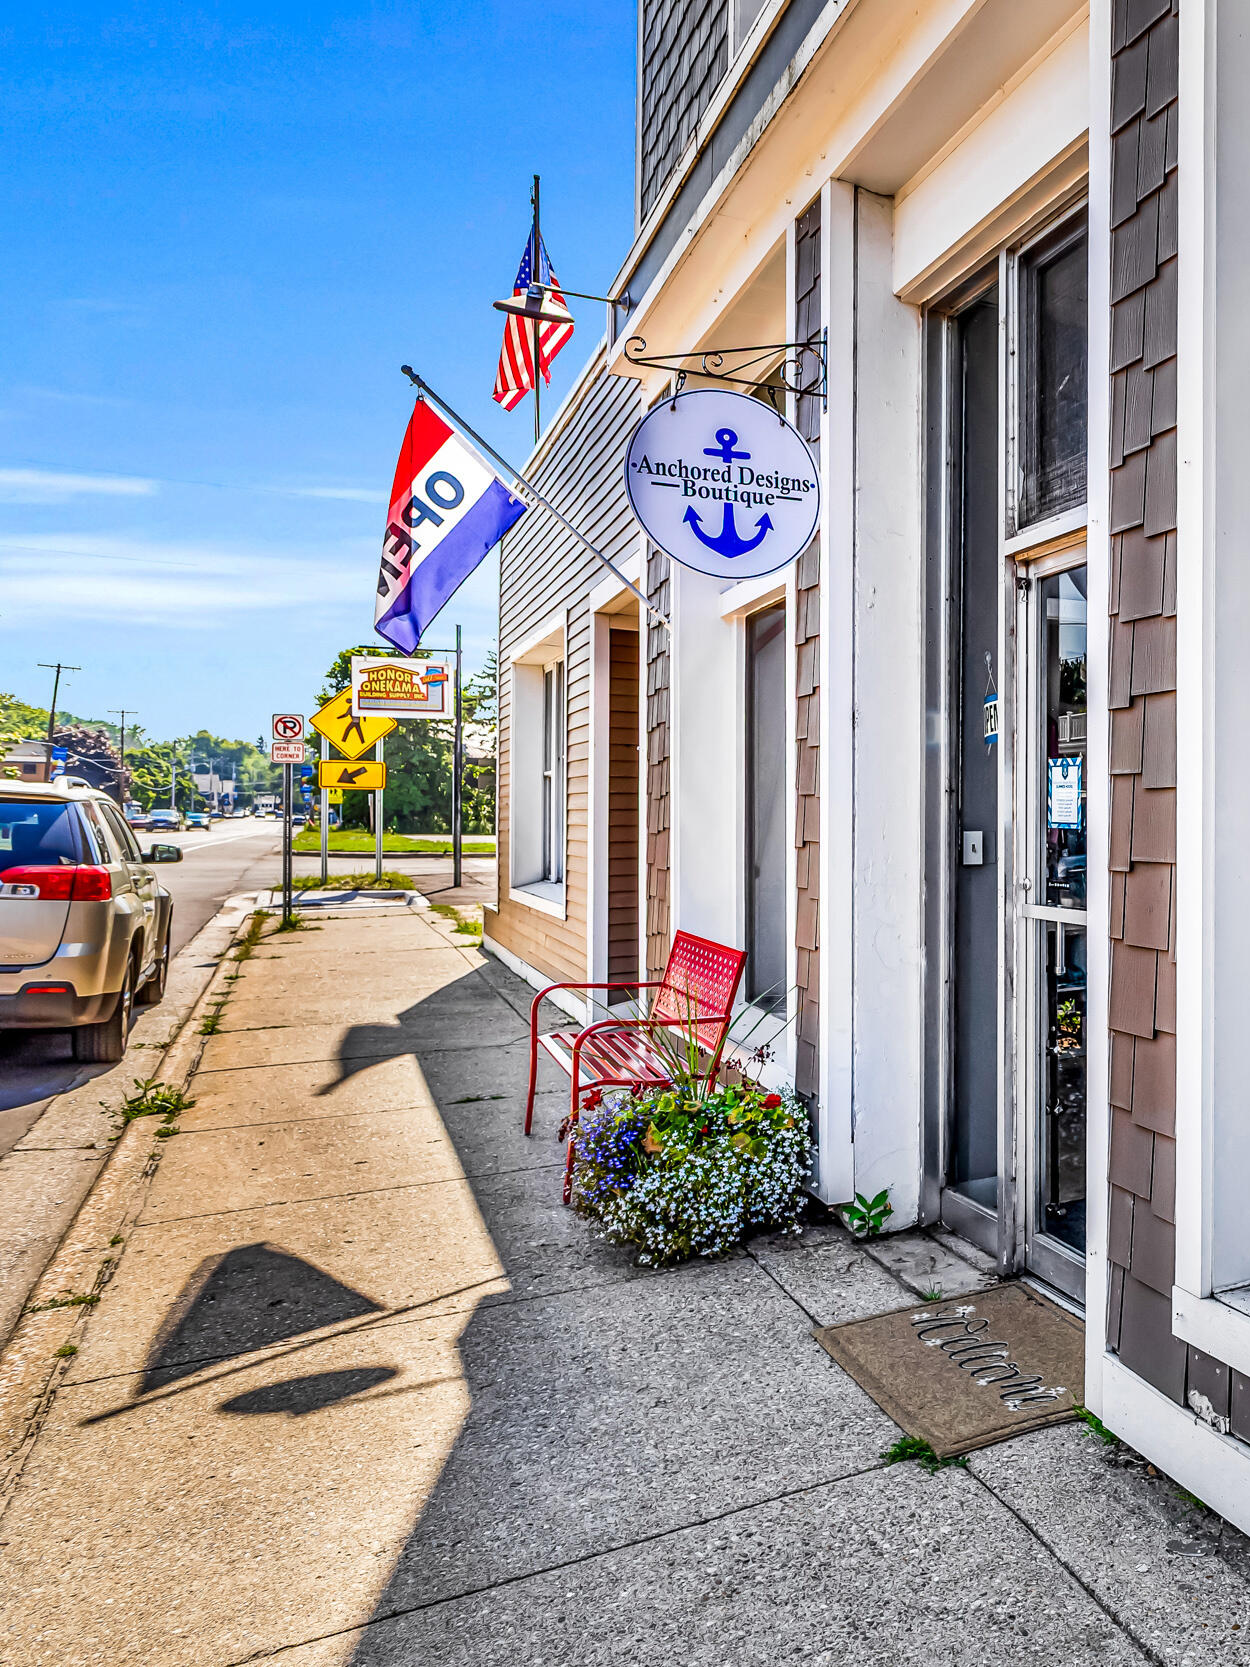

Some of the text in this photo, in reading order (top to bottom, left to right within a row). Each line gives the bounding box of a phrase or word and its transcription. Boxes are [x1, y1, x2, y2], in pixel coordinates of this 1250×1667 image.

[637, 454, 810, 495] Anchored Designs
[681, 478, 775, 508] Boutique
[369, 669, 412, 682] HONOR
[362, 680, 420, 693] ONEKAMA
